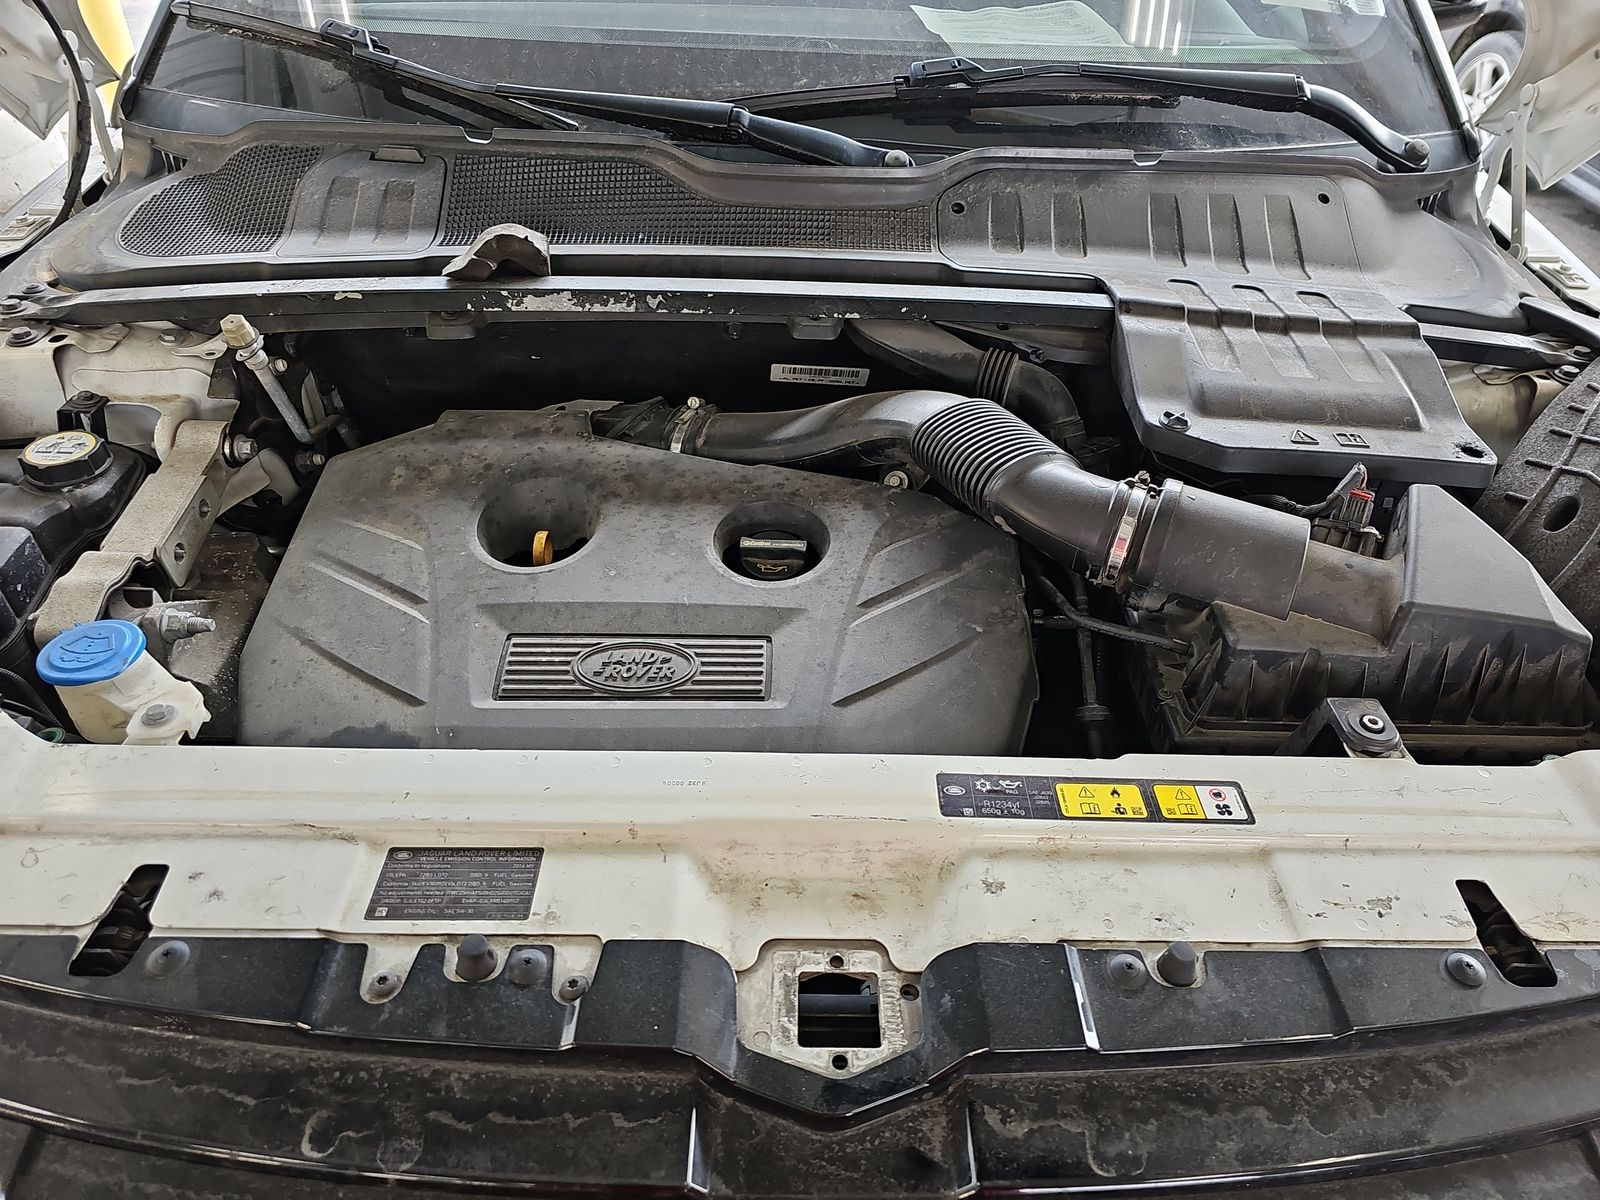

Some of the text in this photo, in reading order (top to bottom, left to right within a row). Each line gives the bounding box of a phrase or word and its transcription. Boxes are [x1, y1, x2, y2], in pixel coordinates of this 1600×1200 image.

[602, 650, 664, 666] LAND
[603, 664, 676, 682] ROVER
[984, 800, 1020, 809] R1234yf
